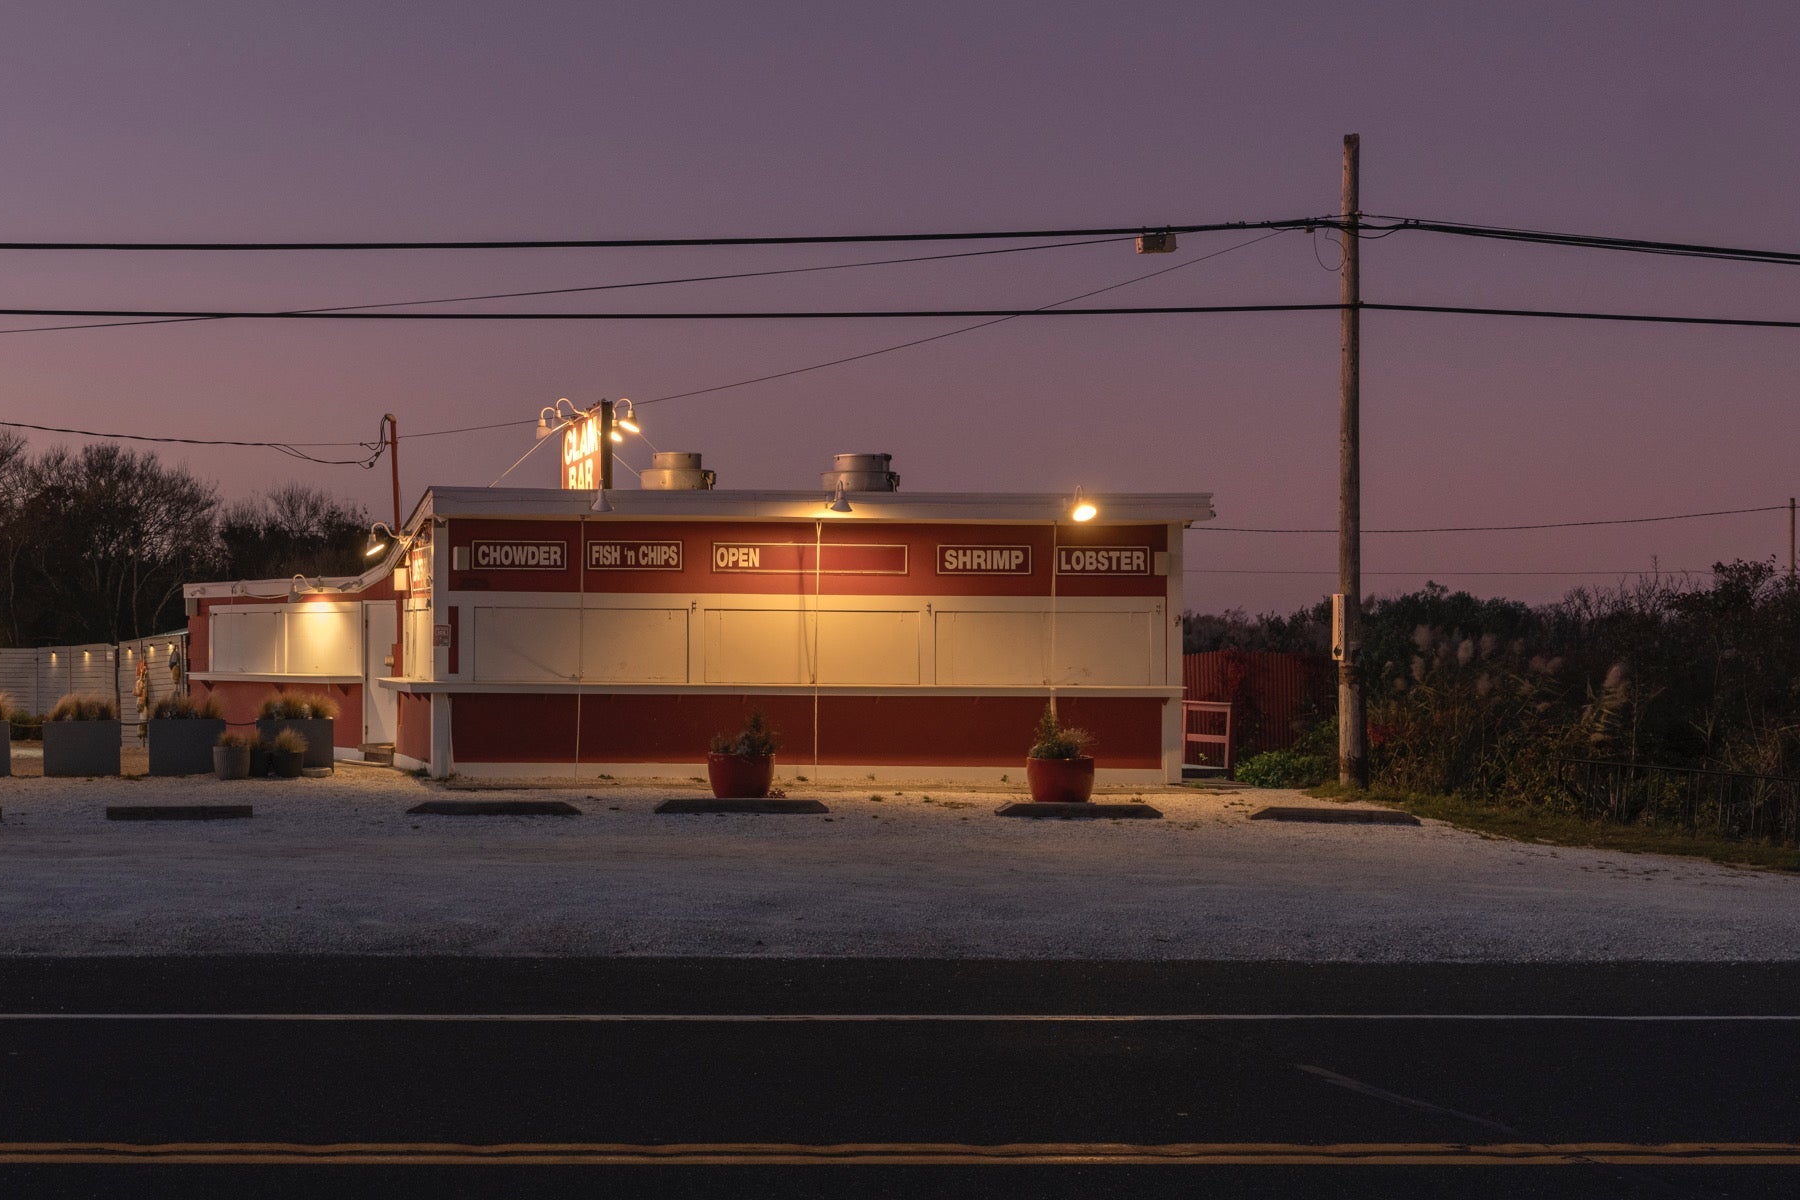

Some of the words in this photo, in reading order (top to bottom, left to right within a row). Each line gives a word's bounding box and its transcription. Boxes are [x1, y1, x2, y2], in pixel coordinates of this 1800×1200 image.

[564, 416, 598, 465] CLAM
[568, 458, 593, 490] BAR
[477, 545, 562, 566] CHOWDER
[591, 545, 621, 565] FISH
[638, 545, 678, 566] CHIPS
[716, 547, 760, 568] OPEN
[944, 549, 1024, 570] SHRIMP
[1060, 550, 1145, 571] LOBSTER
